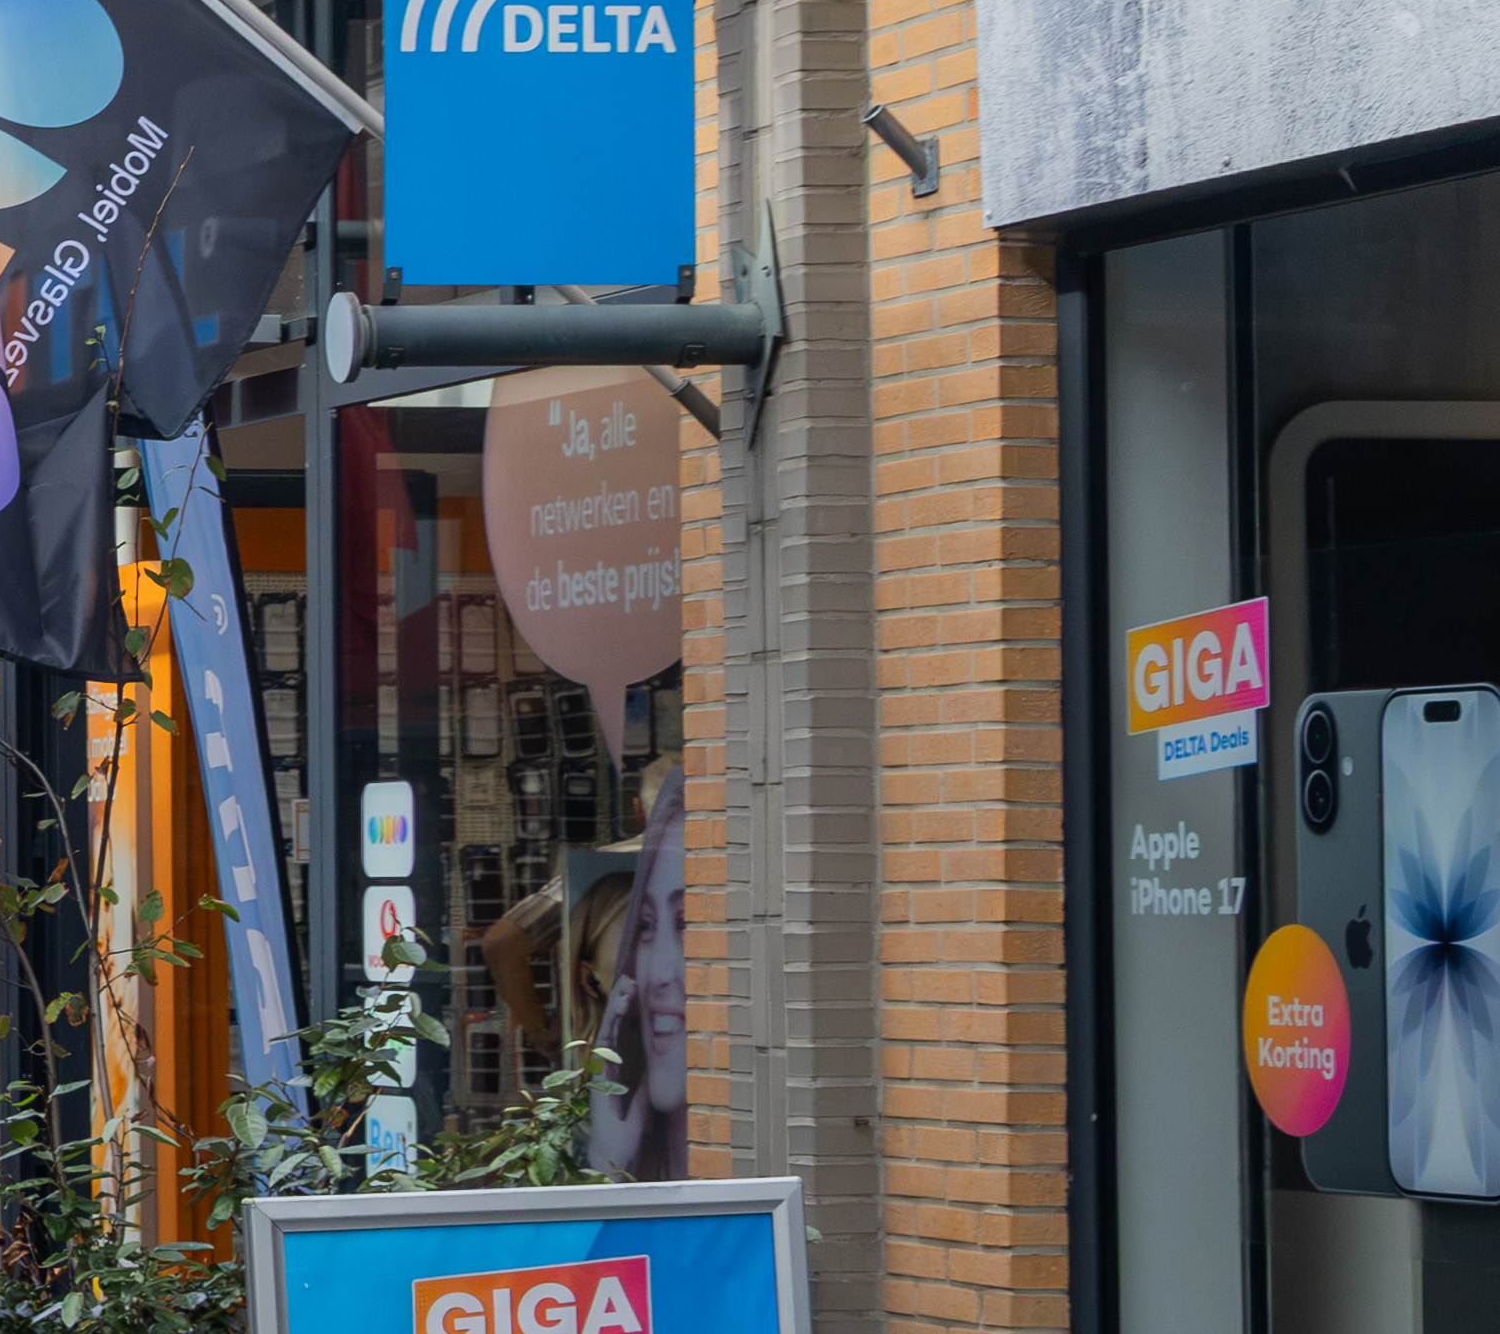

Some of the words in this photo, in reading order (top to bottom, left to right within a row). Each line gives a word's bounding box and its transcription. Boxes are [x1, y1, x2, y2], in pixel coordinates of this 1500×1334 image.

[500, 3, 677, 54] DELTA
[600, 400, 637, 451] alle
[530, 479, 640, 537] netwerken
[646, 483, 675, 521] en
[526, 565, 552, 612] de
[556, 558, 619, 609] beste
[623, 546, 681, 614] prijs!
[1132, 621, 1263, 714] GIGA
[1163, 734, 1207, 763] DELTA
[1210, 726, 1250, 754] Deals
[1129, 820, 1200, 870] Apple
[1129, 878, 1212, 916] iPhone
[1217, 876, 1246, 915] 17
[1266, 994, 1324, 1027] Extra
[1258, 1037, 1335, 1081] Korting
